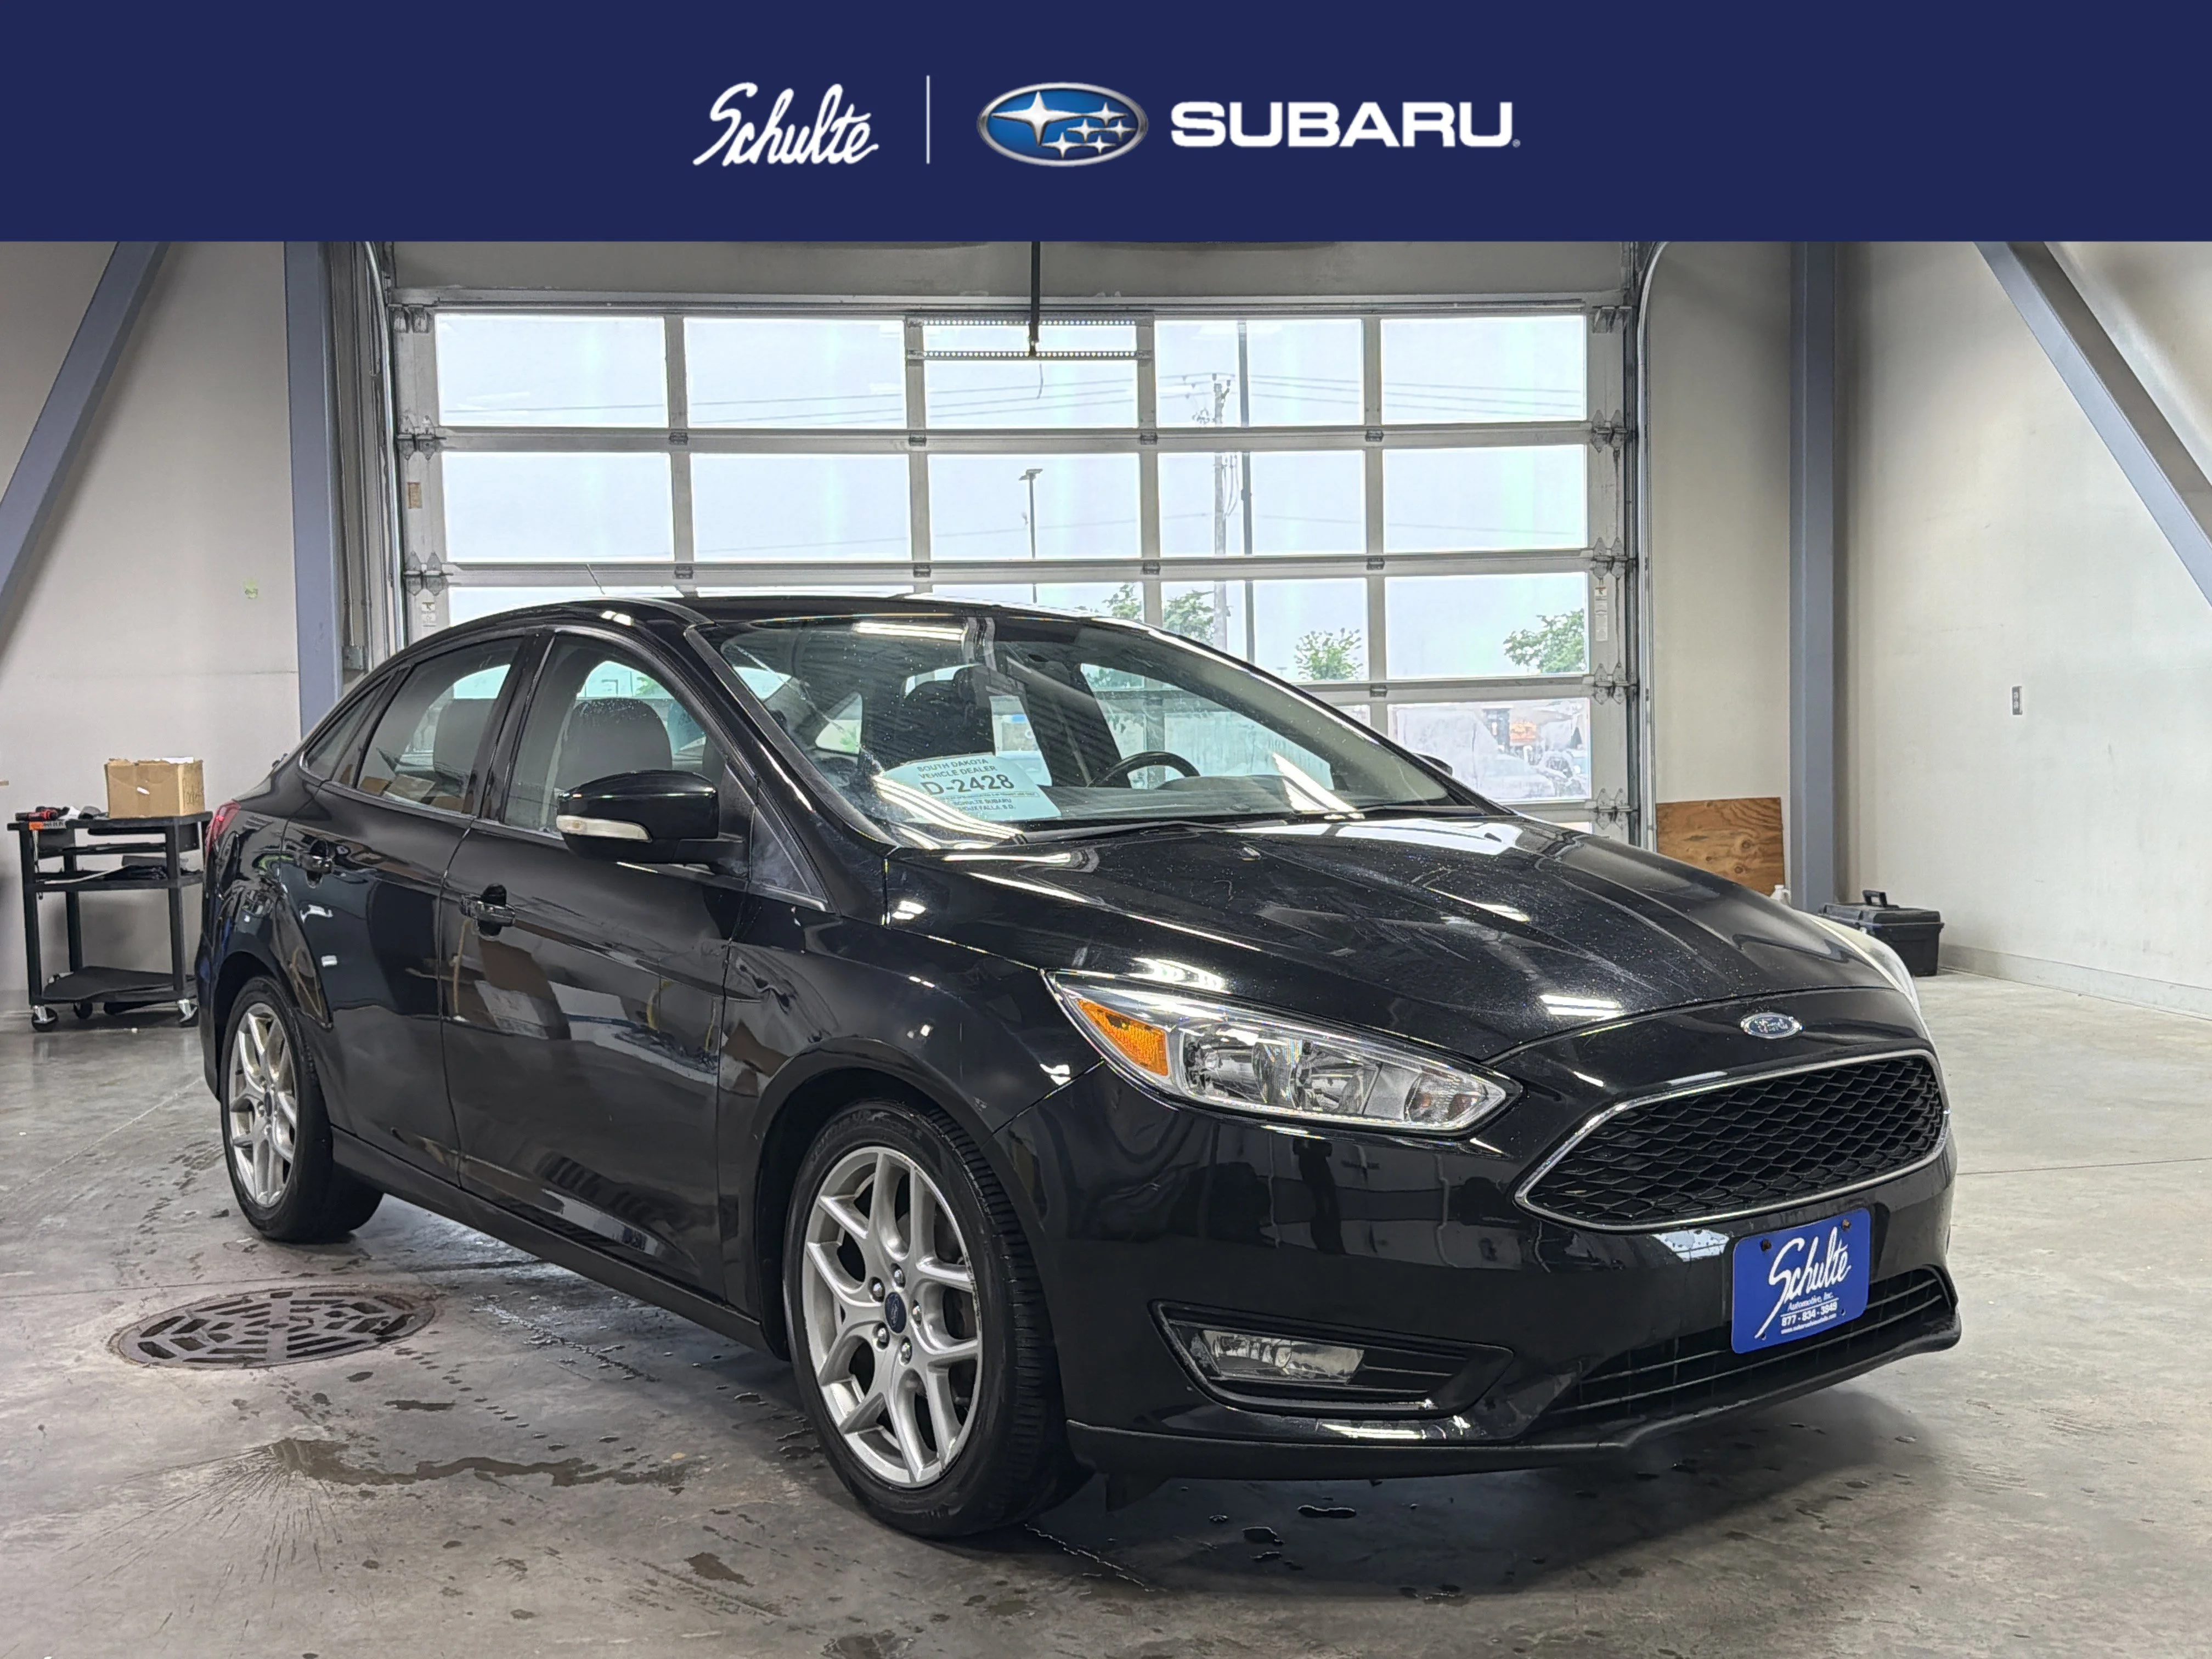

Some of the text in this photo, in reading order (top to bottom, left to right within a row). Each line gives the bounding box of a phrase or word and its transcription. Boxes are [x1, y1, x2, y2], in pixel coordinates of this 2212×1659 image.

[917, 758, 989, 772] SOUTH DAKOTA
[918, 765, 997, 779] VEHICLE DEALER
[920, 774, 1014, 795] D-2428
[1754, 1226, 1852, 1339] Schulte
[1781, 1314, 1797, 1327] 877
[1802, 1308, 1816, 1321] 834
